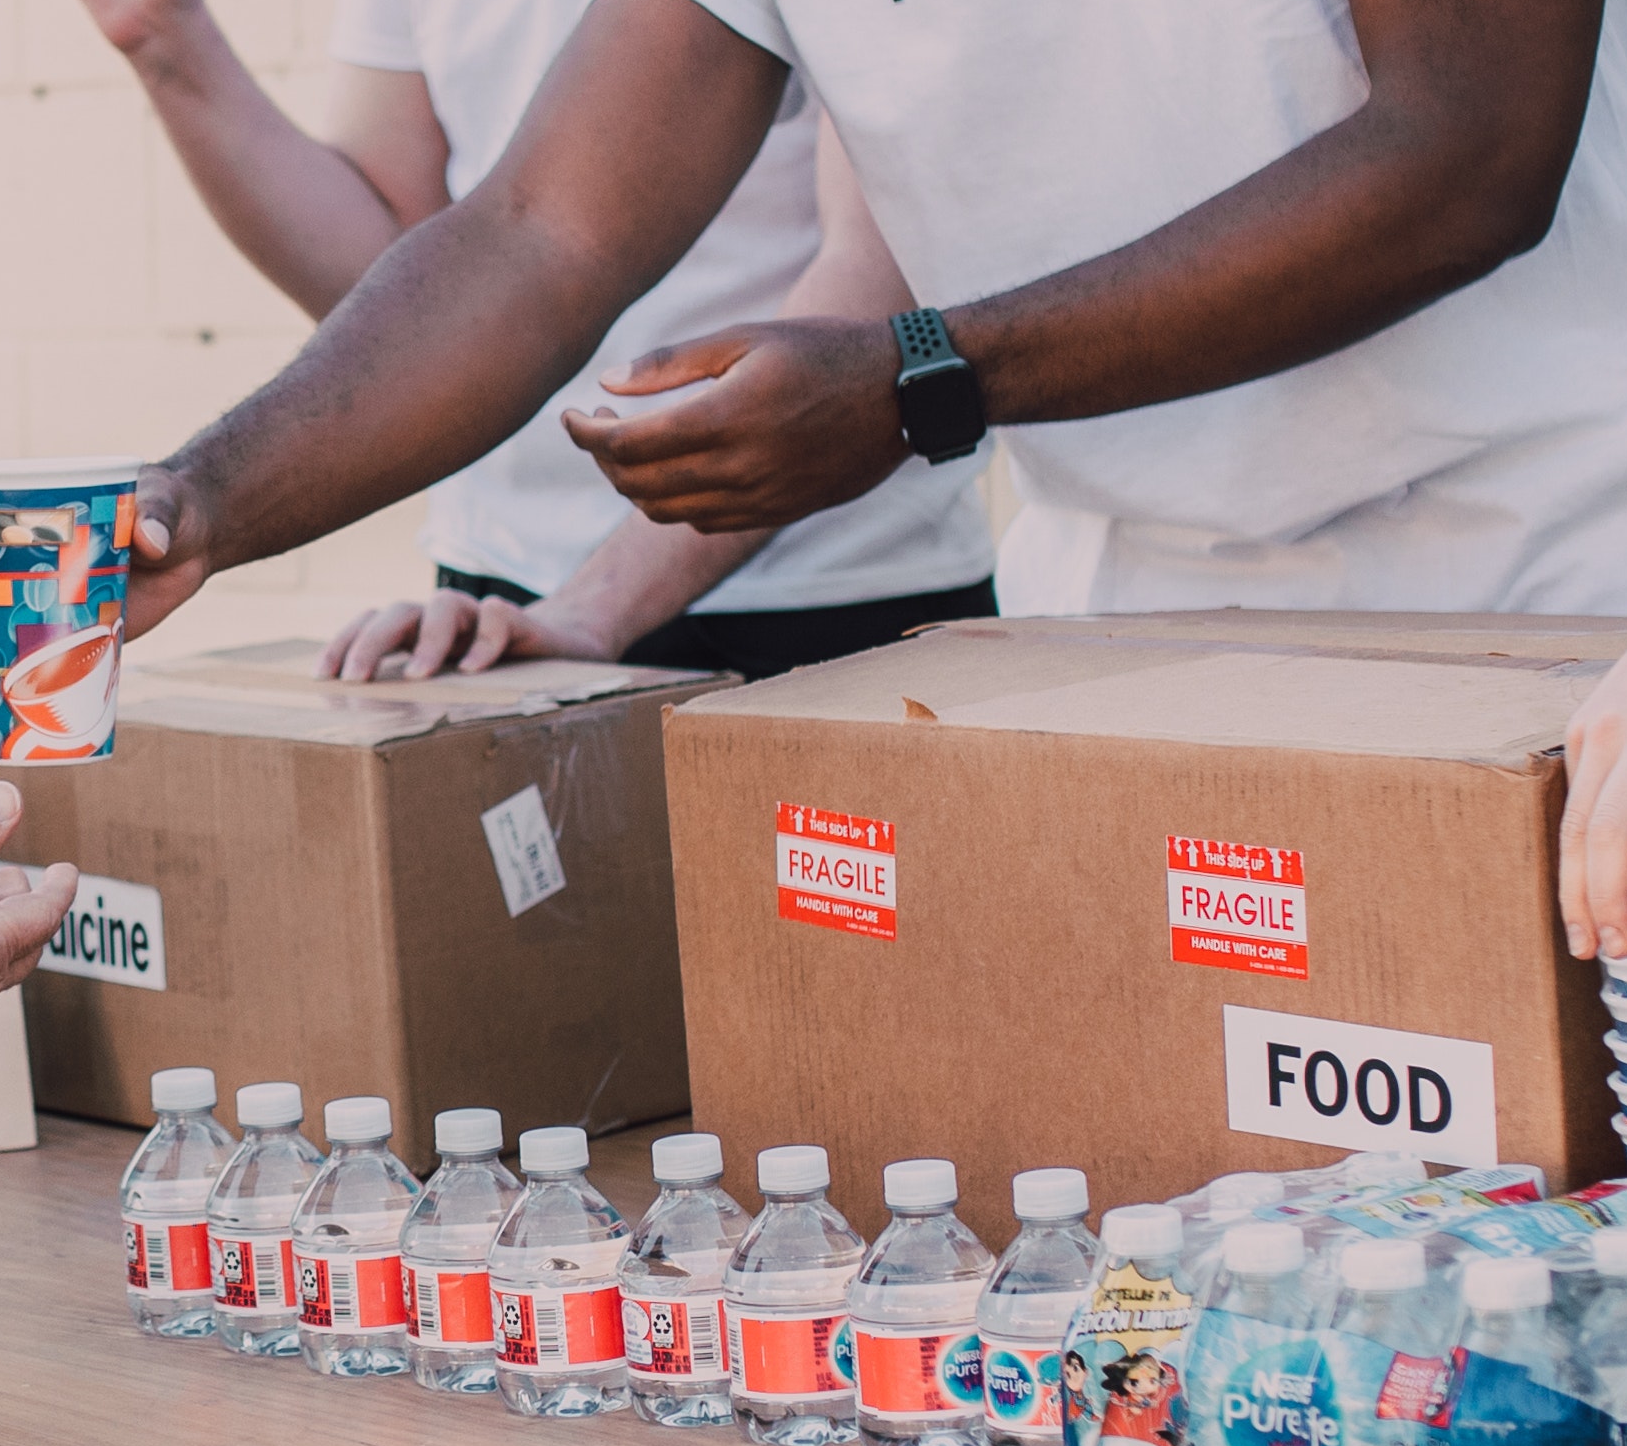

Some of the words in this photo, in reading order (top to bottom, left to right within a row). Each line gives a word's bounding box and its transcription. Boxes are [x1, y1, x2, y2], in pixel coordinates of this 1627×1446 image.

[809, 818, 827, 833] THIS
[829, 822, 848, 838] SIDE
[788, 848, 886, 896] FRAGILE
[1205, 852, 1226, 867] THIS
[1227, 854, 1250, 870] SIDE
[1250, 858, 1266, 872] UP
[796, 895, 831, 914] HANDLE
[831, 902, 854, 918] WITH
[854, 907, 879, 924] CARE
[1181, 885, 1295, 932] FRAGILE
[1191, 935, 1232, 954] HANDLE
[1232, 941, 1257, 958] WITH
[1258, 945, 1288, 962] CARE
[1266, 1041, 1453, 1134] FOOD
[945, 1362, 980, 1379] Pure
[1222, 1393, 1309, 1440] Pure
